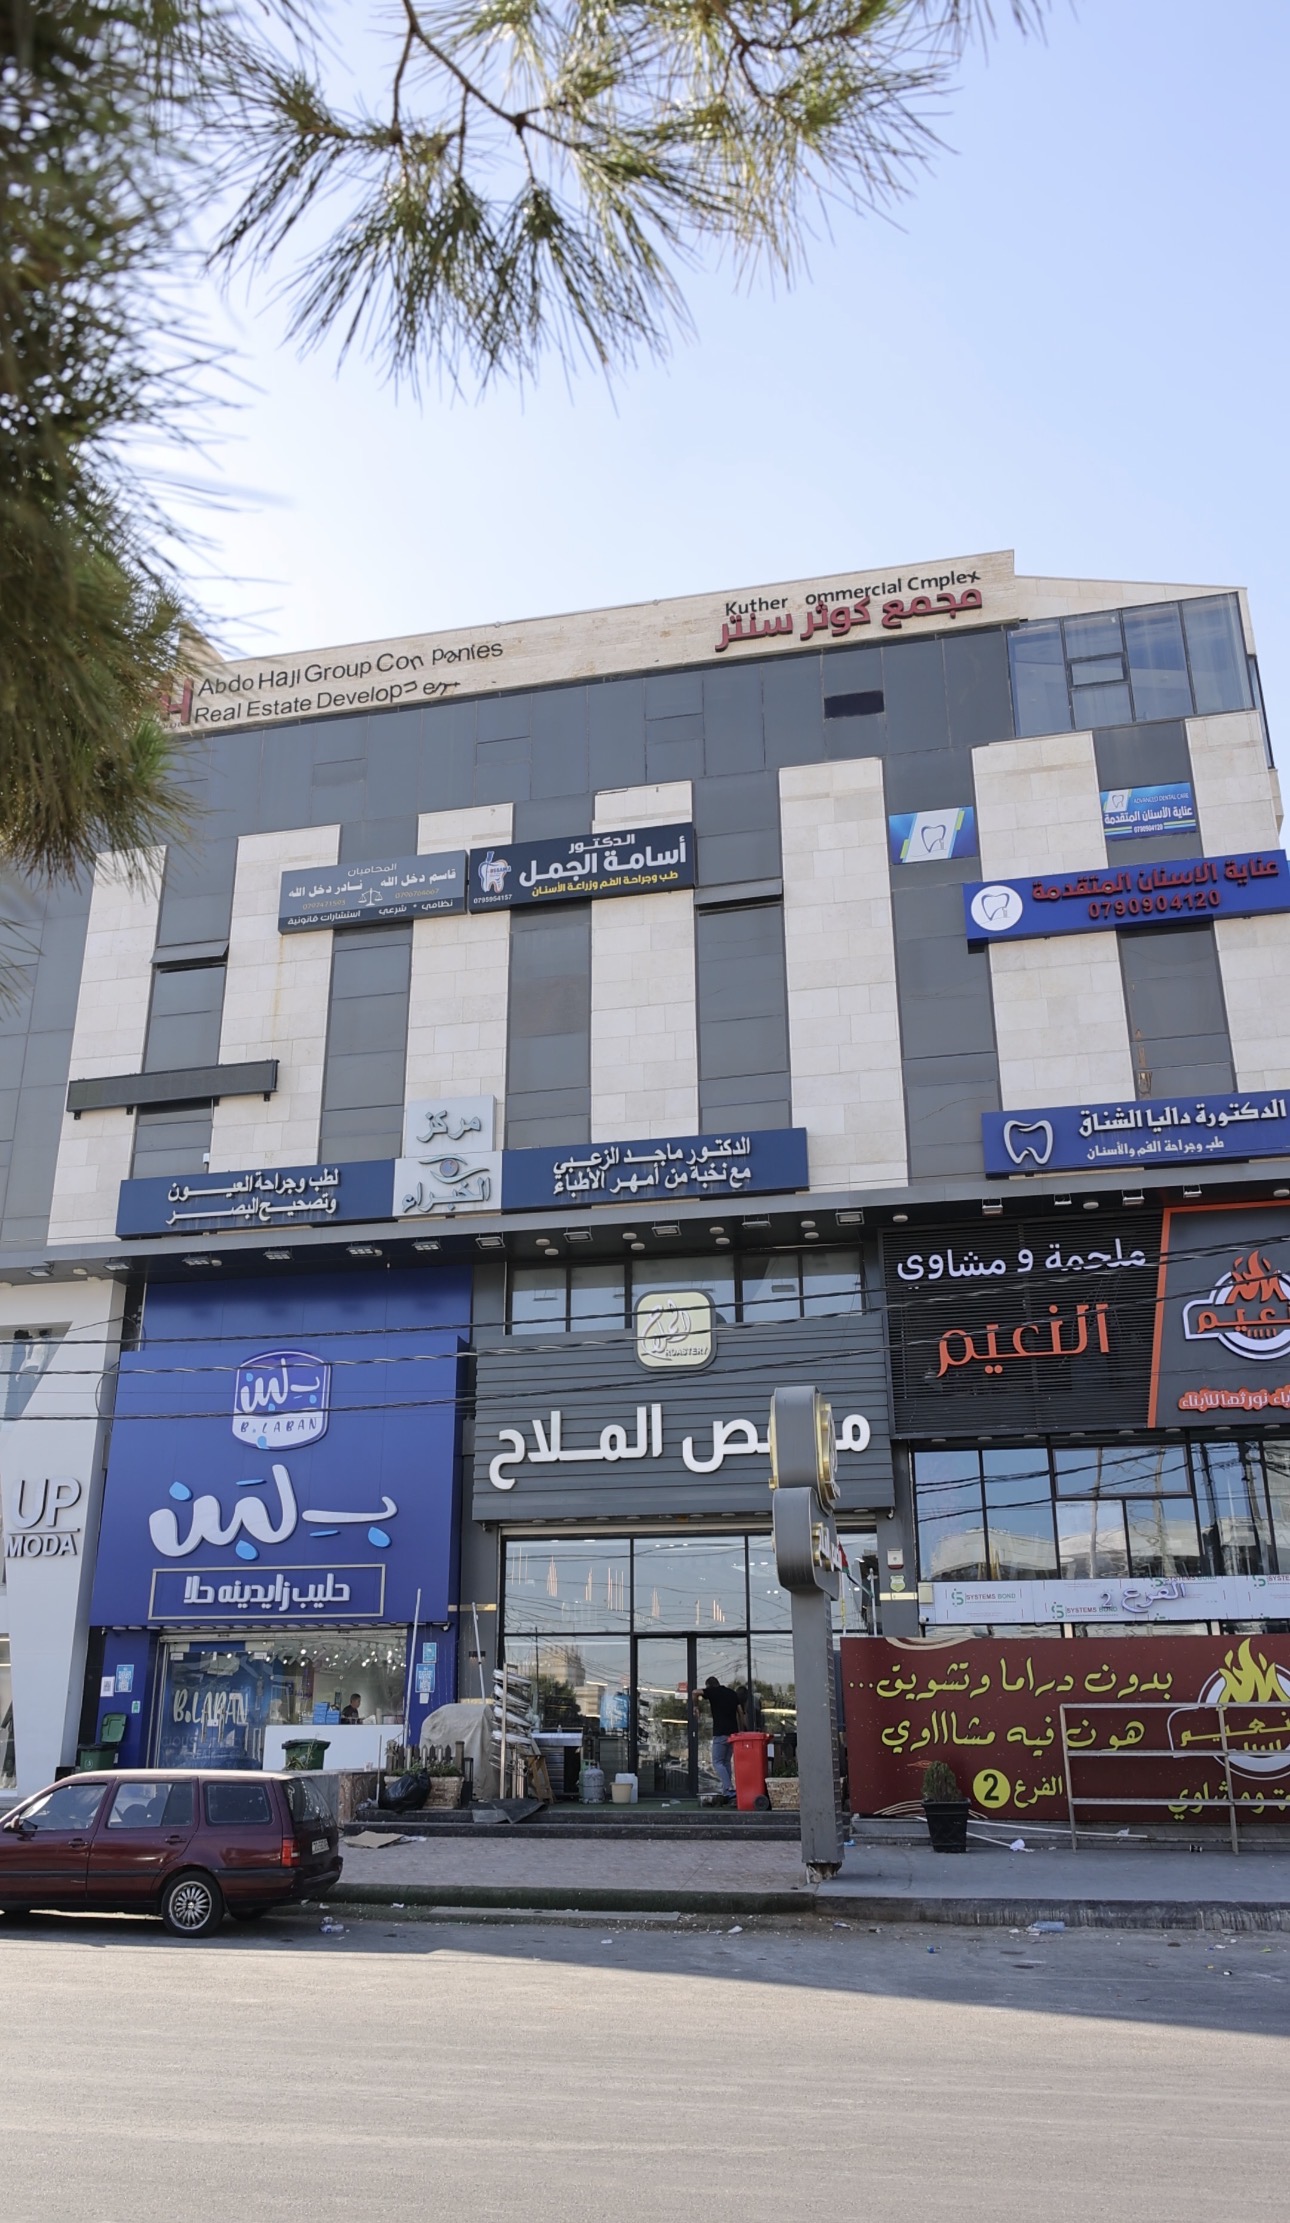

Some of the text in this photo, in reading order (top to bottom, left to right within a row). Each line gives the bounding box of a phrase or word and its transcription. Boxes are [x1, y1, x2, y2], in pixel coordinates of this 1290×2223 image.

[725, 596, 788, 616] Kuther
[907, 570, 981, 592] Cmplex
[714, 587, 983, 653] مجمع كوثر سنتر
[197, 674, 255, 697] Abdo
[304, 660, 372, 683] Group
[195, 702, 242, 724] Real
[246, 695, 312, 718] Estate
[1104, 811, 1140, 825] المتقدمة
[1172, 805, 1193, 818] عناية
[568, 834, 636, 854] الدكتور
[380, 868, 457, 887] قاسم دخل الله
[519, 835, 687, 887] أسامة الجمل
[659, 870, 679, 881] طب
[1224, 857, 1280, 885] عناية
[288, 880, 363, 898] نادر دخل الله
[567, 880, 598, 893] وزراعة
[599, 878, 622, 890] الفم
[623, 874, 658, 886] وجراحة
[1032, 871, 1132, 901] المتقدمة
[320, 910, 361, 922] استشارات
[378, 904, 407, 916] شرعي
[1088, 889, 1221, 920] 0790904120
[416, 1109, 481, 1144] مركز
[1079, 1098, 1287, 1138] الدكتورة داليا الشناق
[553, 1136, 750, 1175] الدكتور ماجد الزعبي
[1087, 1135, 1225, 1160] طب وجراحة الفم والأسنان
[168, 1168, 340, 1201] لطب وجراحة العيون
[553, 1161, 752, 1198] مع نخبة من أمهر الأطباء
[166, 1193, 337, 1225] وتصحيح البصر
[896, 1237, 1147, 1290] ملحمة و مشاوي
[936, 1303, 1111, 1378] النعيم
[488, 1402, 664, 1491] الملاح
[681, 1413, 872, 1474] مص
[10, 1477, 82, 1530] UP
[4, 1533, 78, 1558] MODA
[183, 1575, 215, 1604] حلا
[292, 1572, 351, 1609] حليب
[1100, 1580, 1186, 1614] الفرع 2
[1066, 1606, 1097, 1614] SYSTEMS
[1000, 1656, 1074, 1697] دراما
[1083, 1663, 1173, 1700] بدون
[1006, 1715, 1055, 1757] فيه
[1065, 1718, 1146, 1752] هون
[983, 1773, 1063, 1809] الفرع 2
